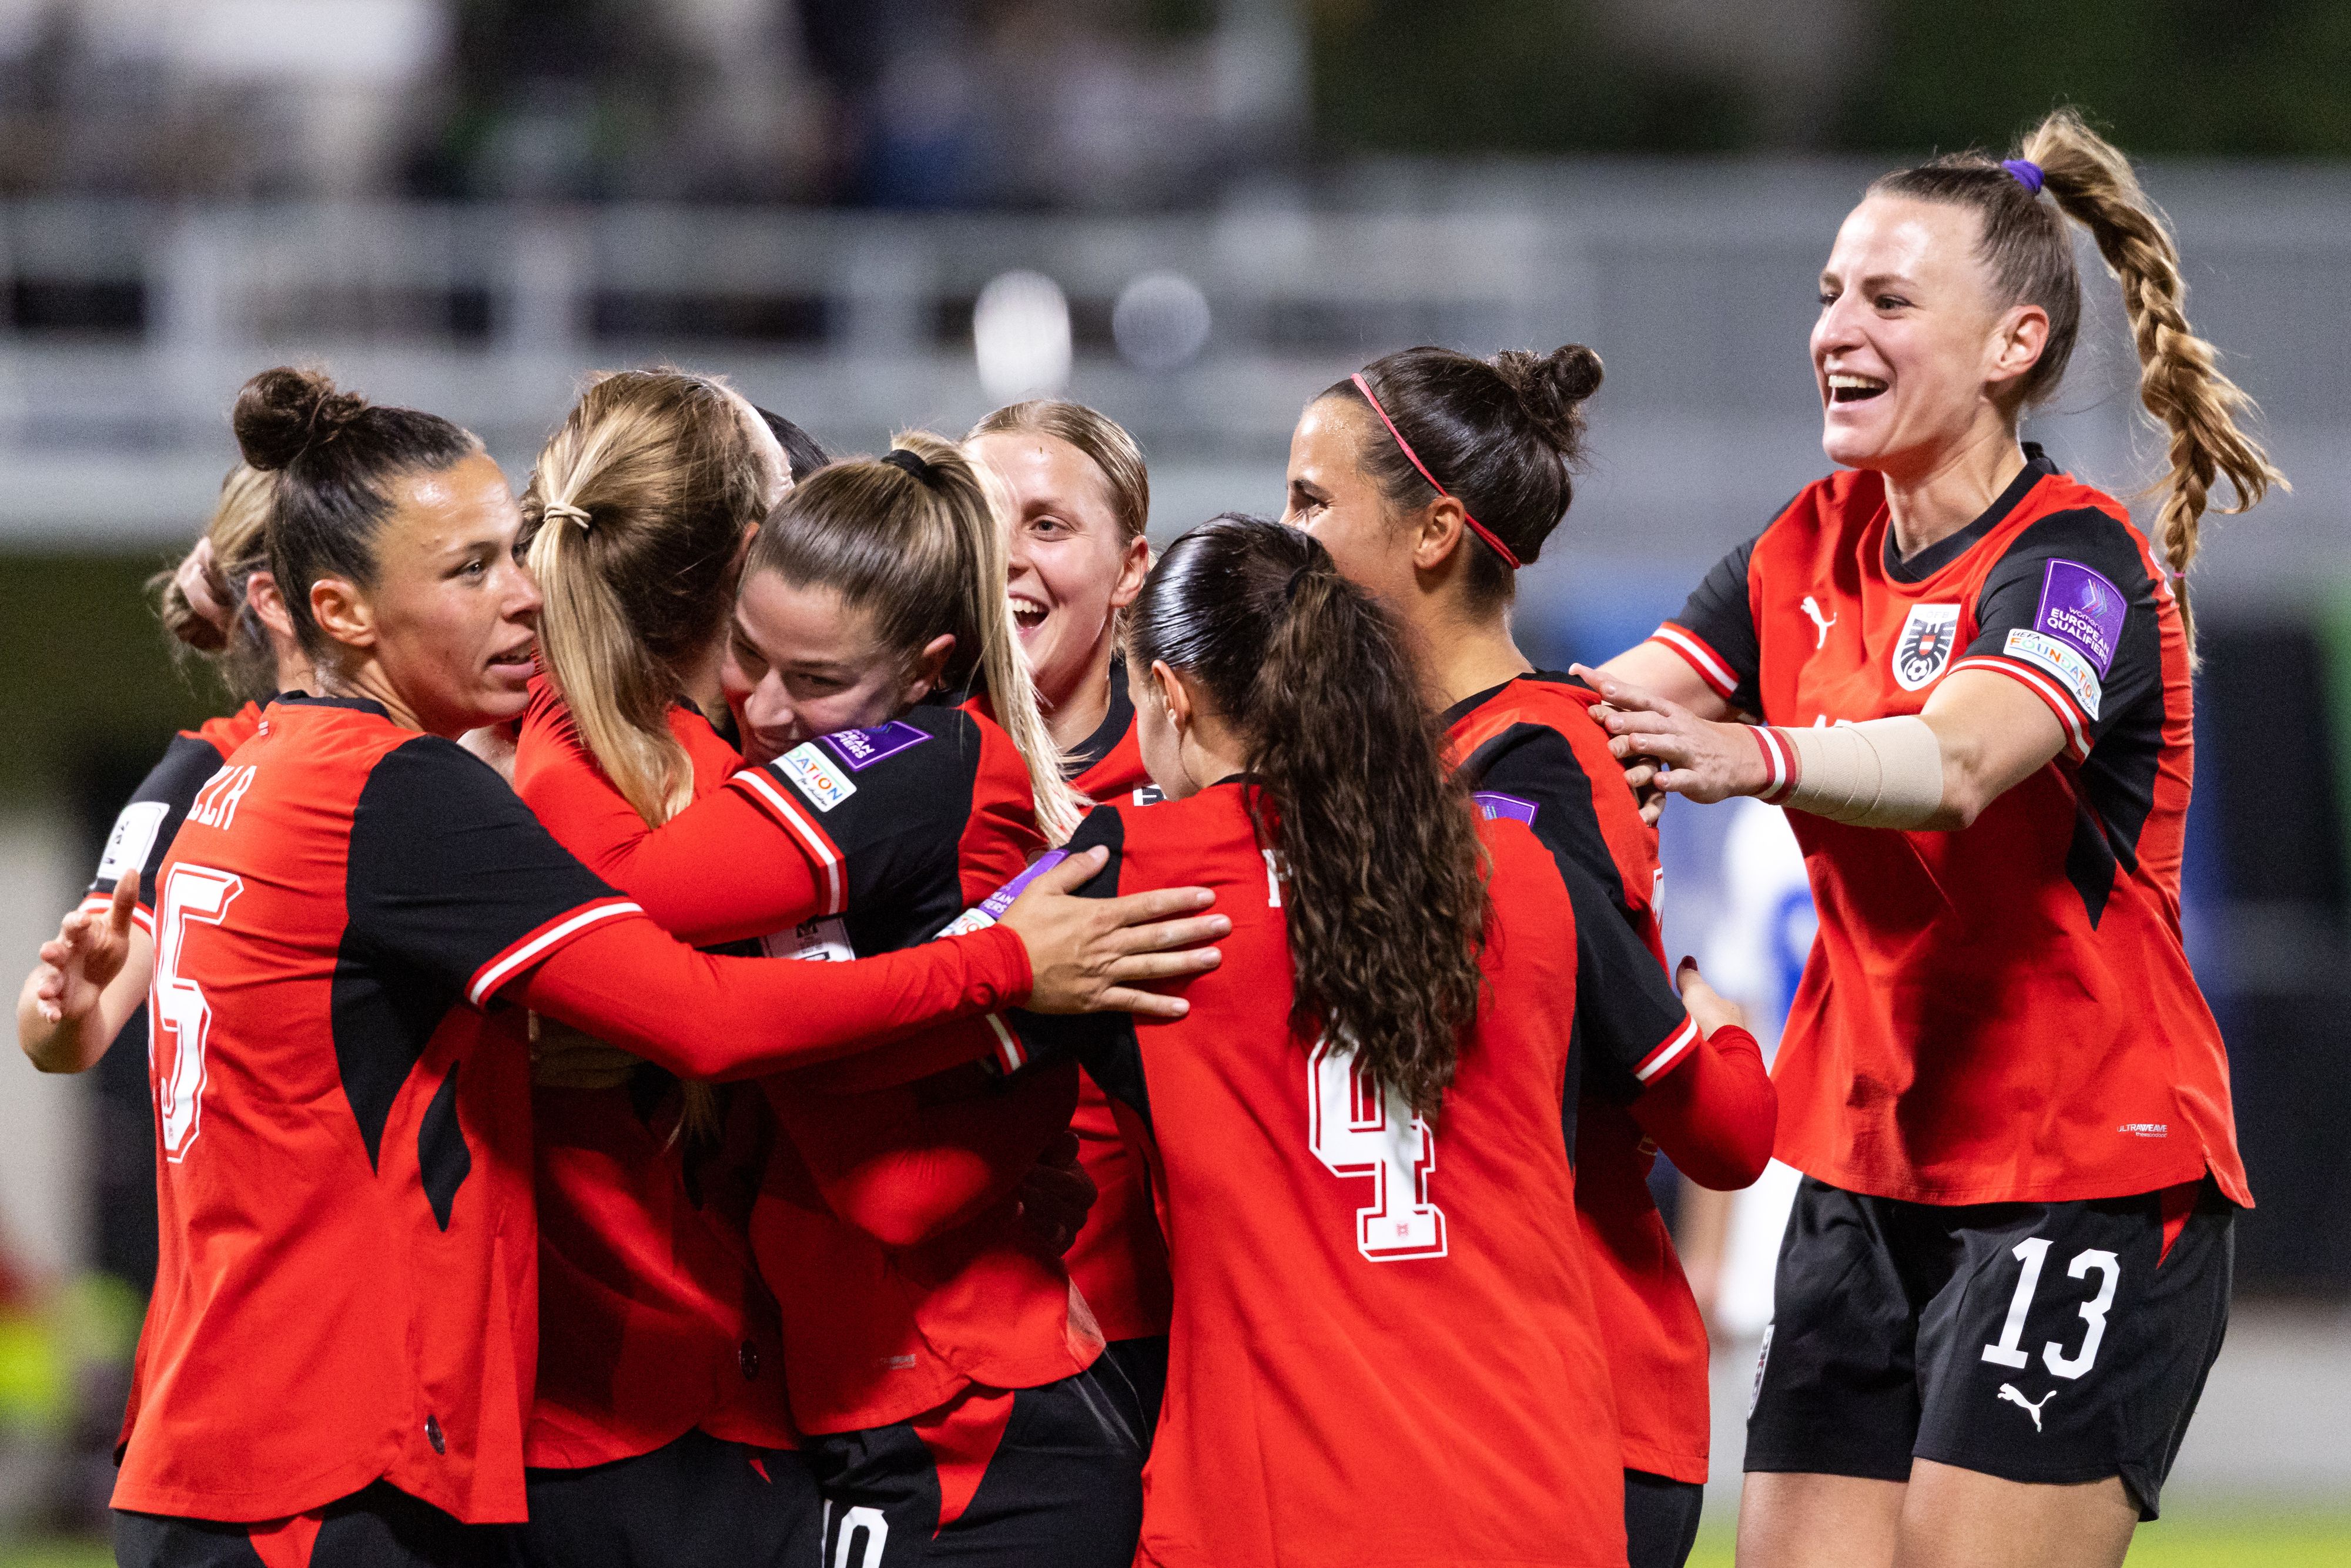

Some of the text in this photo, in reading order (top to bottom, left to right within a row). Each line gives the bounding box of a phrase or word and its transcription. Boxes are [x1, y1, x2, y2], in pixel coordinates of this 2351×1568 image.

[2012, 631, 2040, 641] UEFA
[2047, 617, 2107, 665] QUALIFIERS
[2051, 608, 2109, 655] EUROPEAN
[2069, 606, 2104, 634] women's
[2010, 637, 2097, 706] FOUNDATION
[787, 747, 843, 800] DATION
[149, 862, 244, 1163] 5
[1307, 1018, 1448, 1262] 4
[2117, 1123, 2168, 1132] ULTRAWEAVE
[1981, 1237, 2120, 1380] 13
[821, 1499, 889, 1568] 0
